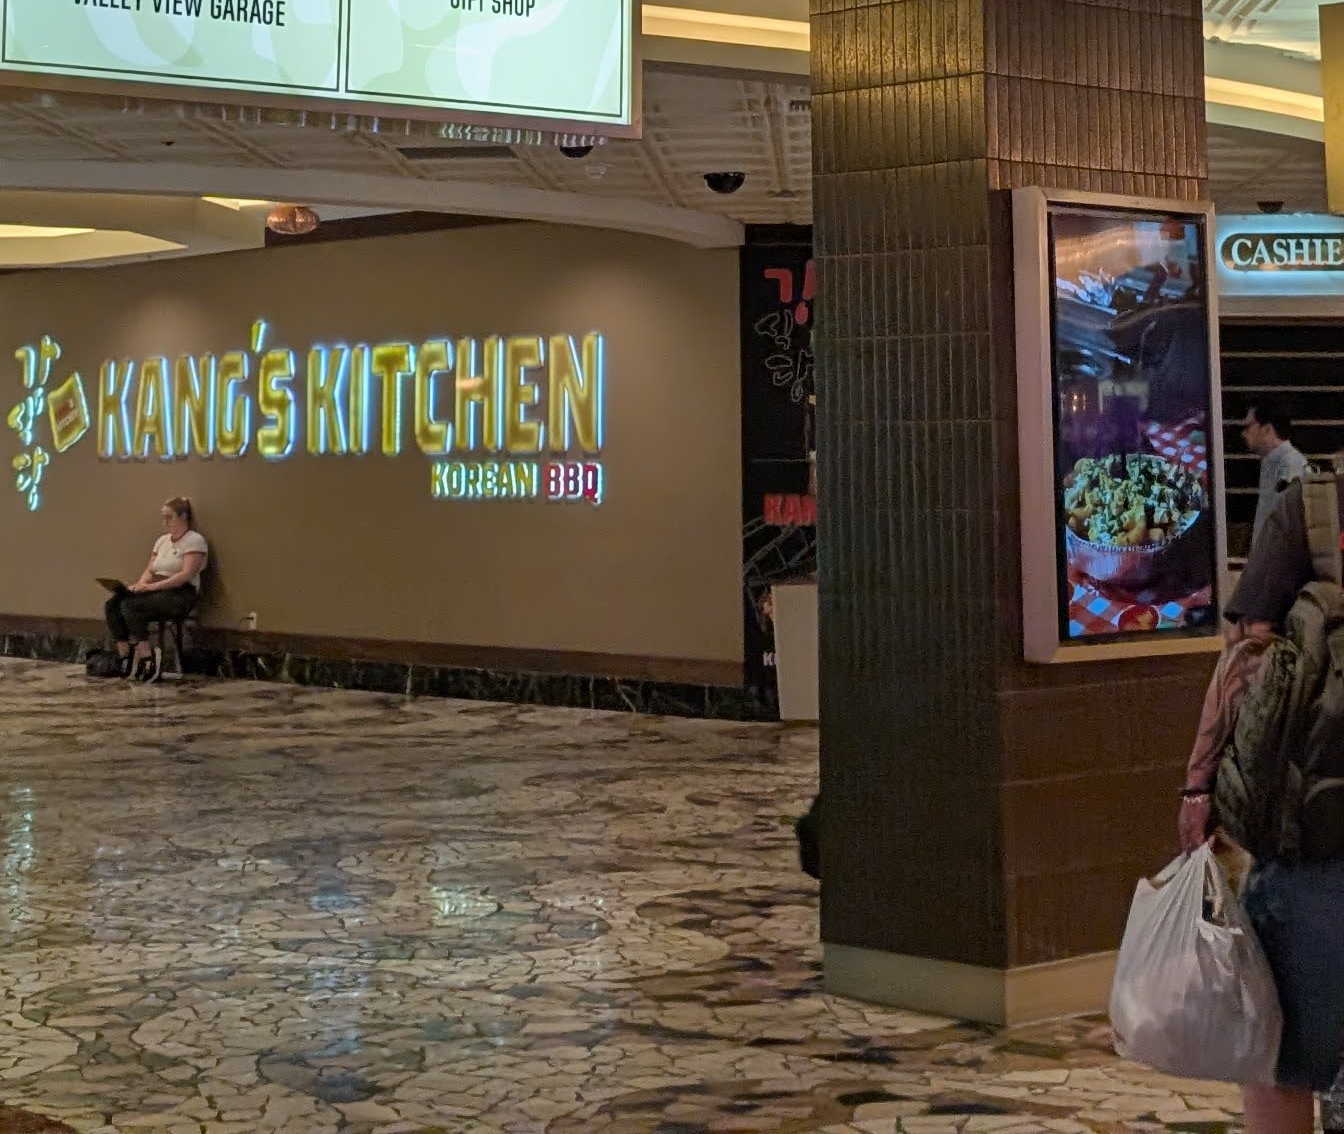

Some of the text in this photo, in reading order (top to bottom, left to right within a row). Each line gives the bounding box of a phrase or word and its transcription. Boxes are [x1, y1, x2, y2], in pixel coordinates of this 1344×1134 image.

[96, 318, 604, 458] KANG'S KITCHEN
[430, 462, 603, 505] KOREAN BBQ
